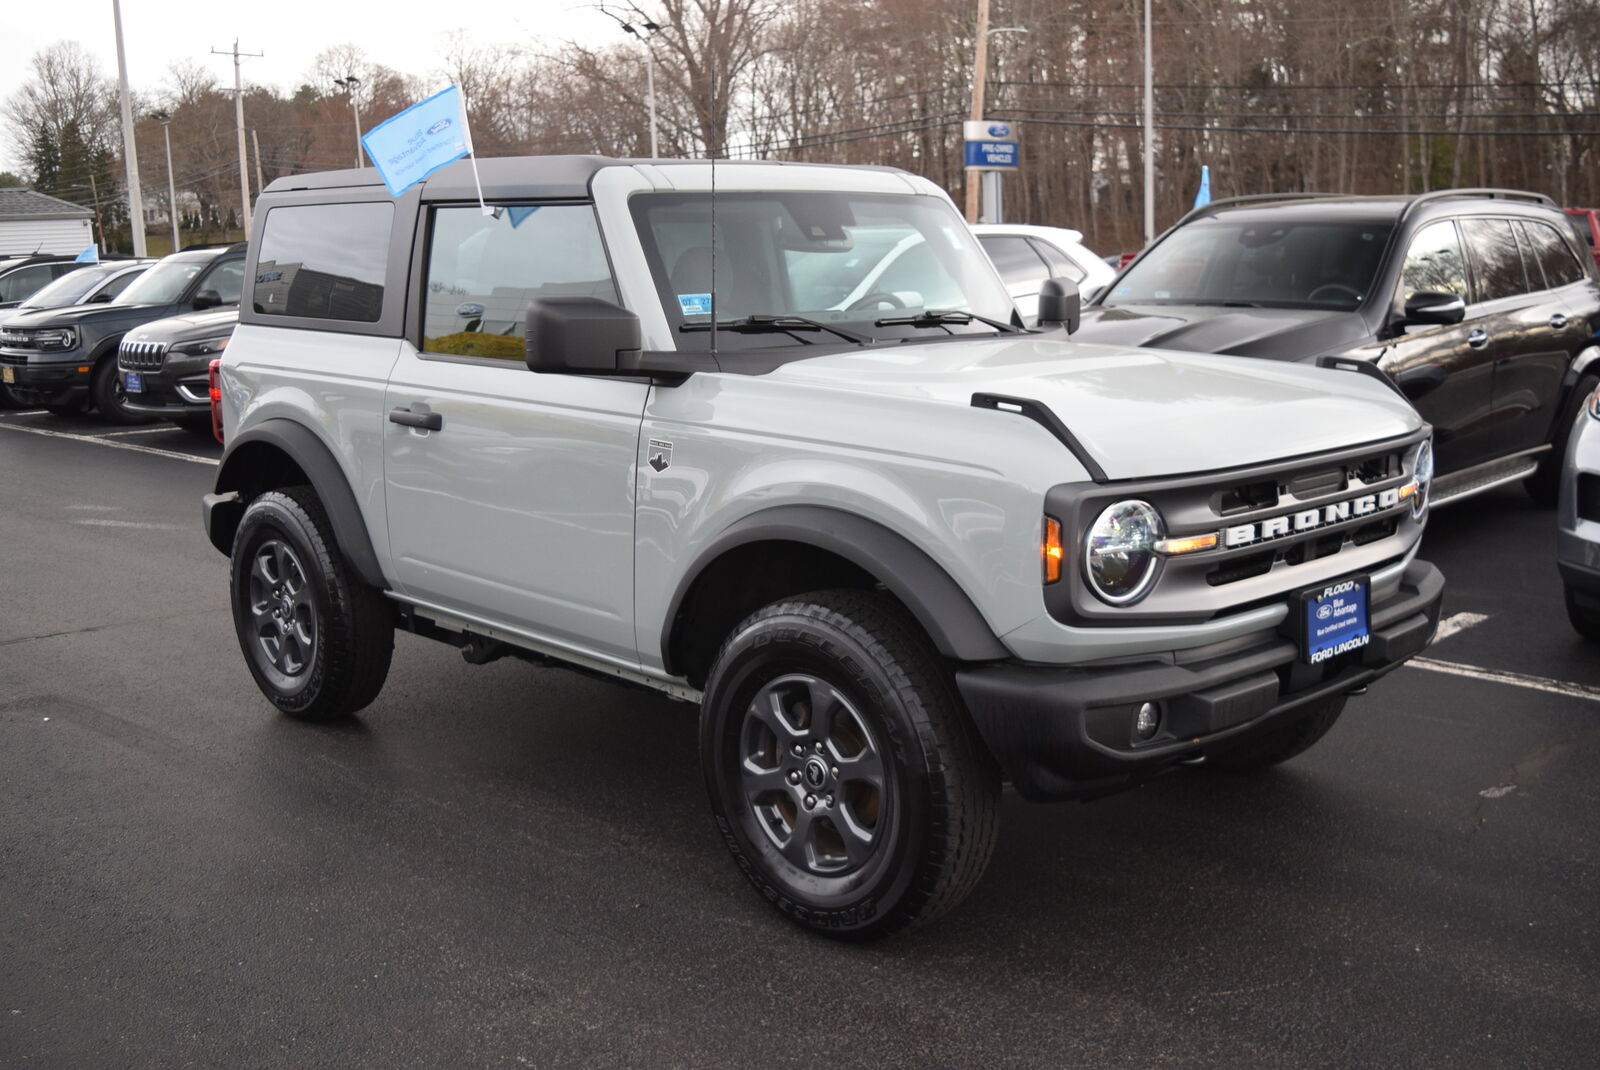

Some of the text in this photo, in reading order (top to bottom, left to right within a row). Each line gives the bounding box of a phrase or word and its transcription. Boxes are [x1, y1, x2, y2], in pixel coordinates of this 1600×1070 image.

[982, 143, 1014, 153] PRE-OWNED
[986, 153, 1012, 163] VEHICLES
[1225, 487, 1400, 547] BRONCO
[1323, 580, 1354, 598] FLOOD
[1332, 598, 1344, 608] Blue
[1333, 603, 1357, 617] Advantage
[1311, 634, 1370, 664] FORD LINCOLN
